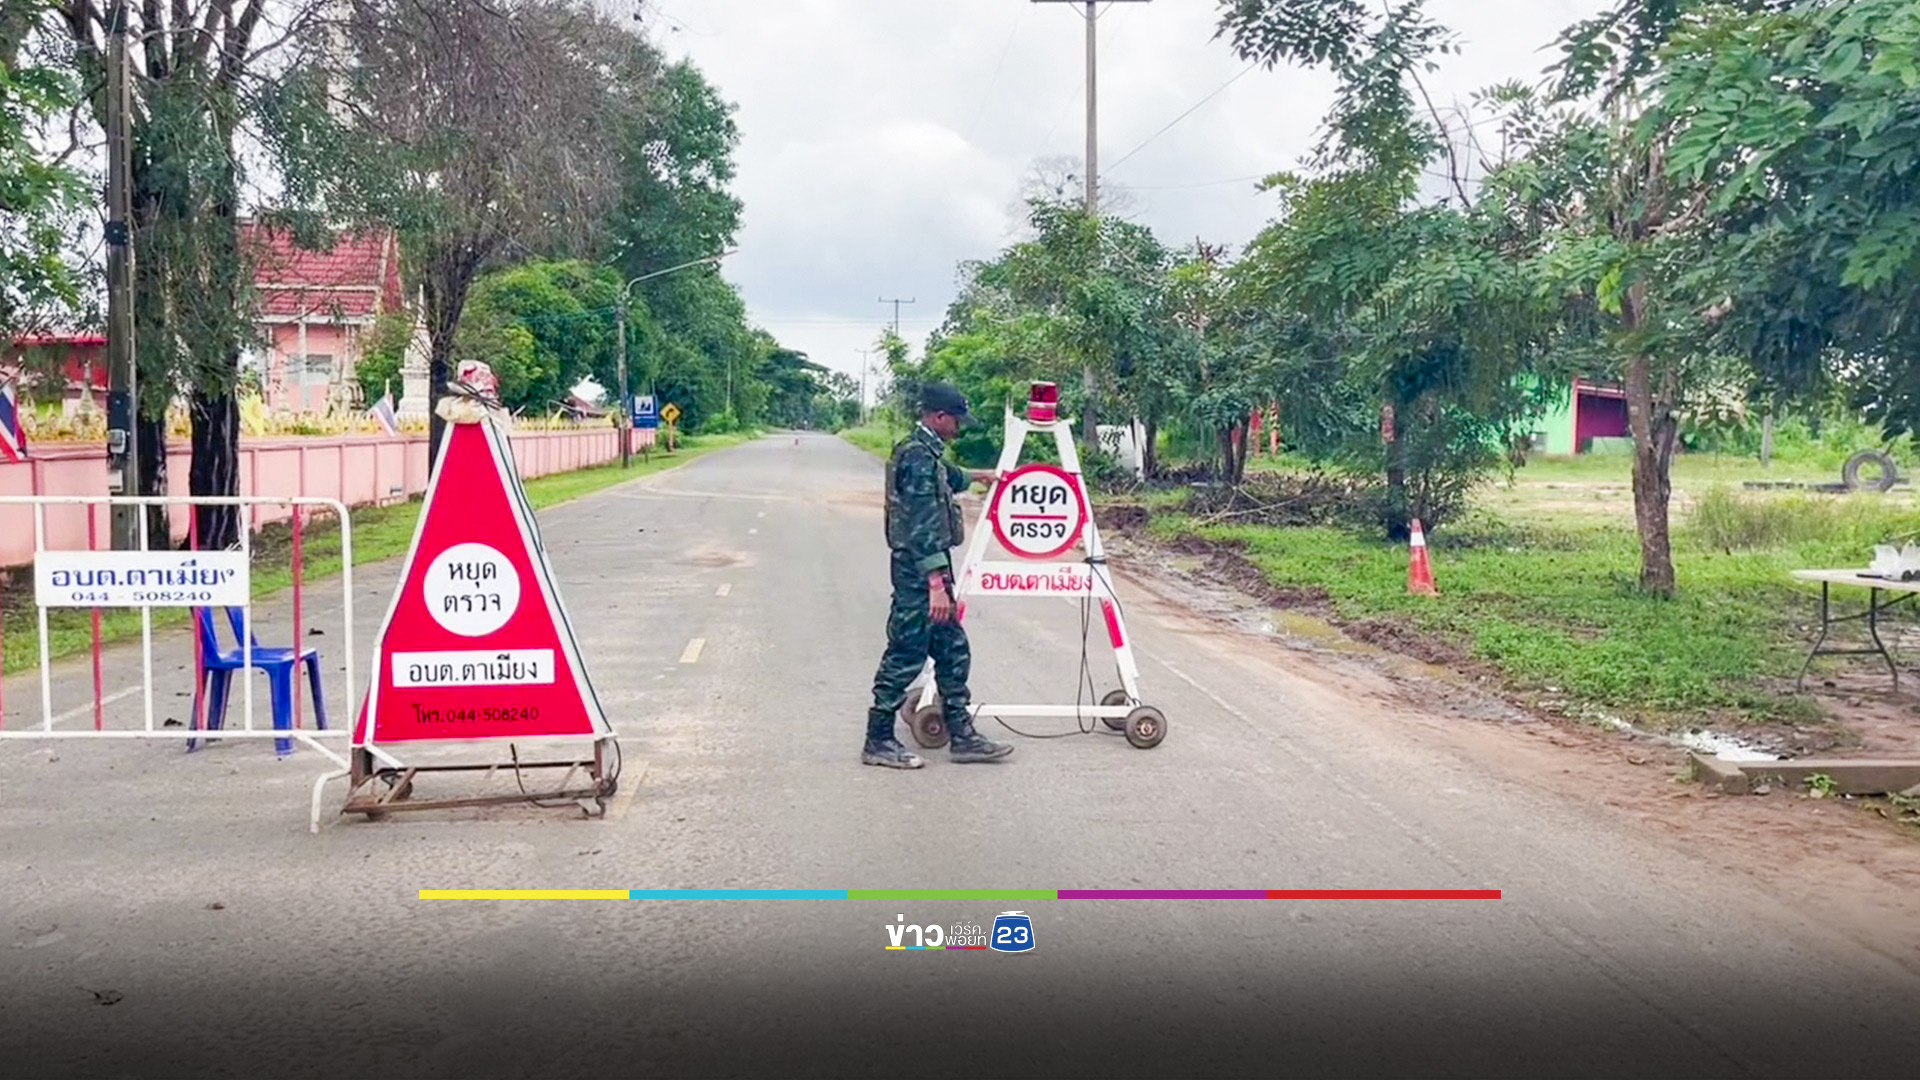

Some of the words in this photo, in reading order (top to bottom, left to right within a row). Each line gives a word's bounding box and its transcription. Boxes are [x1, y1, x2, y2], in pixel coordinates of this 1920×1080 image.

[1011, 484, 1067, 513] หยุด
[1010, 522, 1066, 538] ตรวจ
[448, 561, 497, 588] หยุด
[72, 591, 109, 601] 044
[133, 591, 212, 601] 508240
[444, 593, 501, 613] ตรวจ
[409, 653, 537, 682] อบต.ตาเมียง
